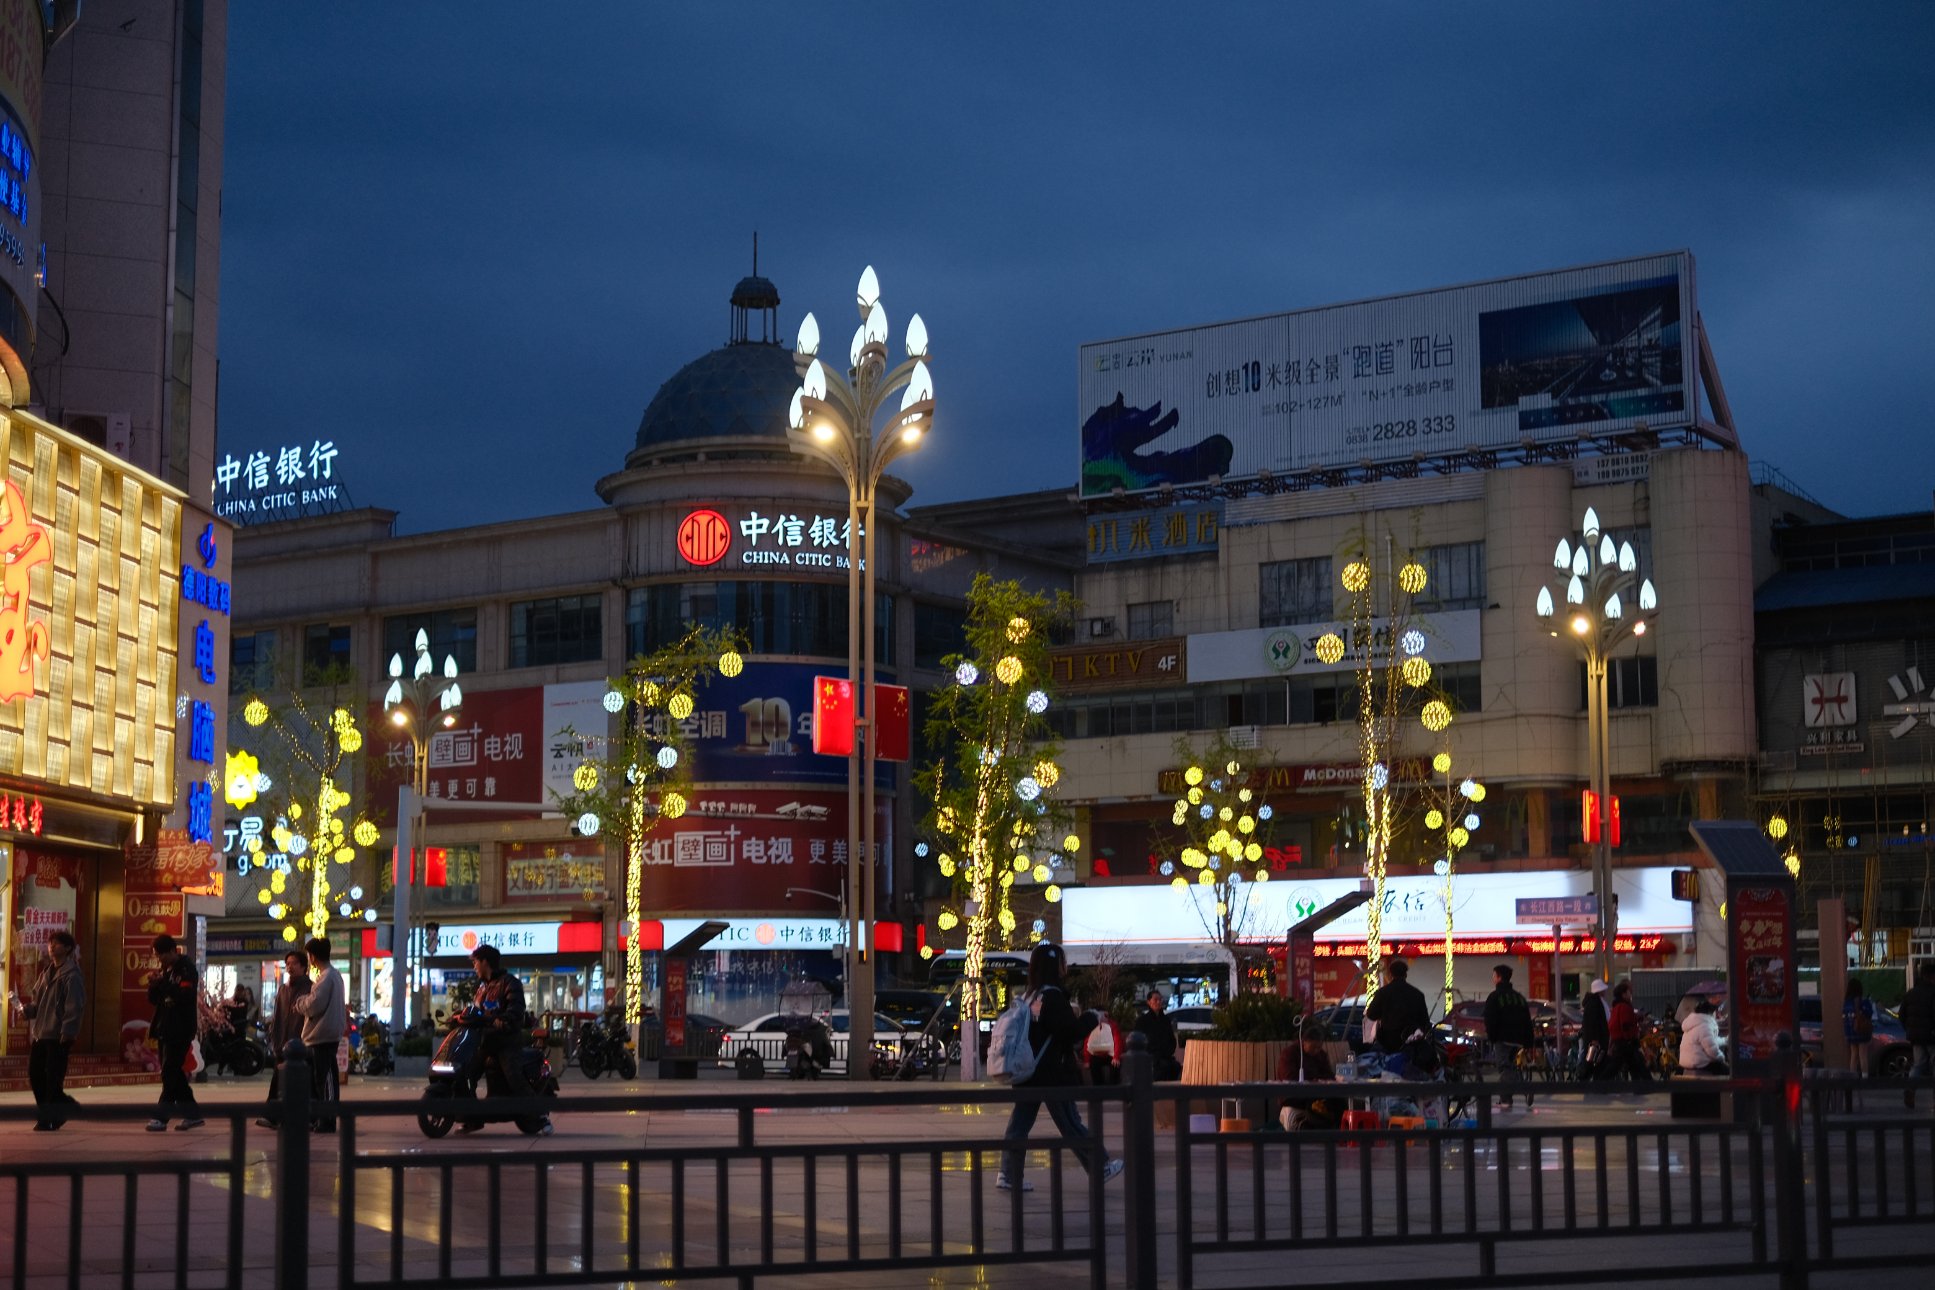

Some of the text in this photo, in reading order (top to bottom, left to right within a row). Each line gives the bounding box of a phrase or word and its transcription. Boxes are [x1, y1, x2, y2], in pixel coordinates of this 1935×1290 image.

[1372, 420, 1417, 442] 2828
[1422, 415, 1455, 436] 333
[217, 440, 338, 495] 中信银行
[217, 485, 337, 517] CHINA CITIC BANK
[740, 511, 866, 549] 中信银行
[742, 551, 866, 571] CHINA CITIC BAK
[1083, 649, 1144, 679] KTV
[1157, 654, 1177, 672] 4F
[739, 697, 791, 745] 10
[479, 931, 535, 948] 中信银行
[780, 924, 850, 945] 中信银行
